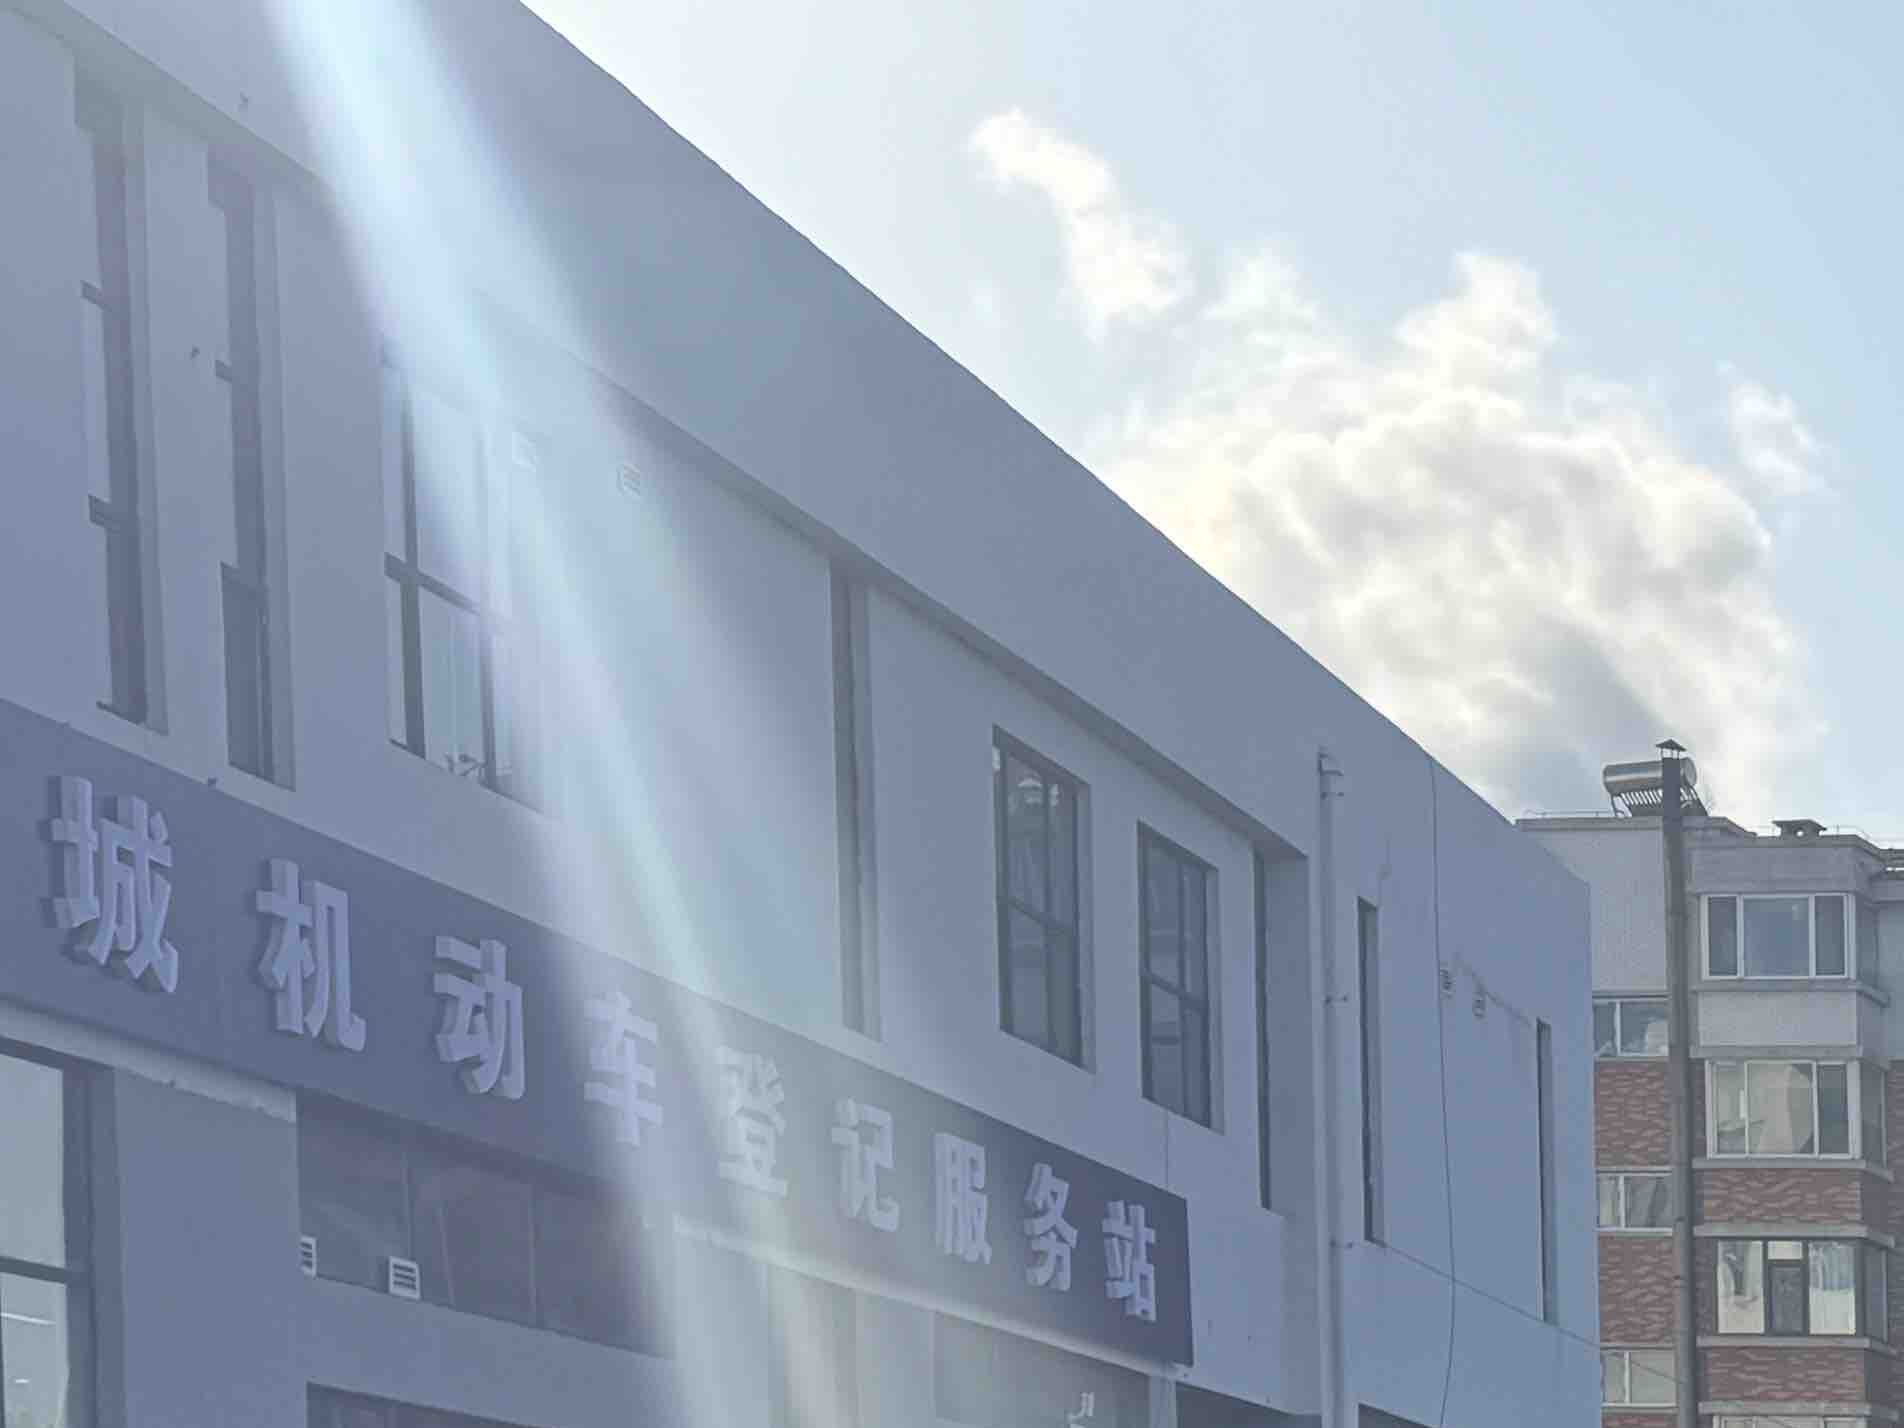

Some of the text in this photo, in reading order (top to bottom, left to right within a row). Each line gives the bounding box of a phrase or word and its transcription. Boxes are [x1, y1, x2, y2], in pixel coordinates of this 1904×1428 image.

[50, 774, 1157, 1322] 城机动车登记服务站
